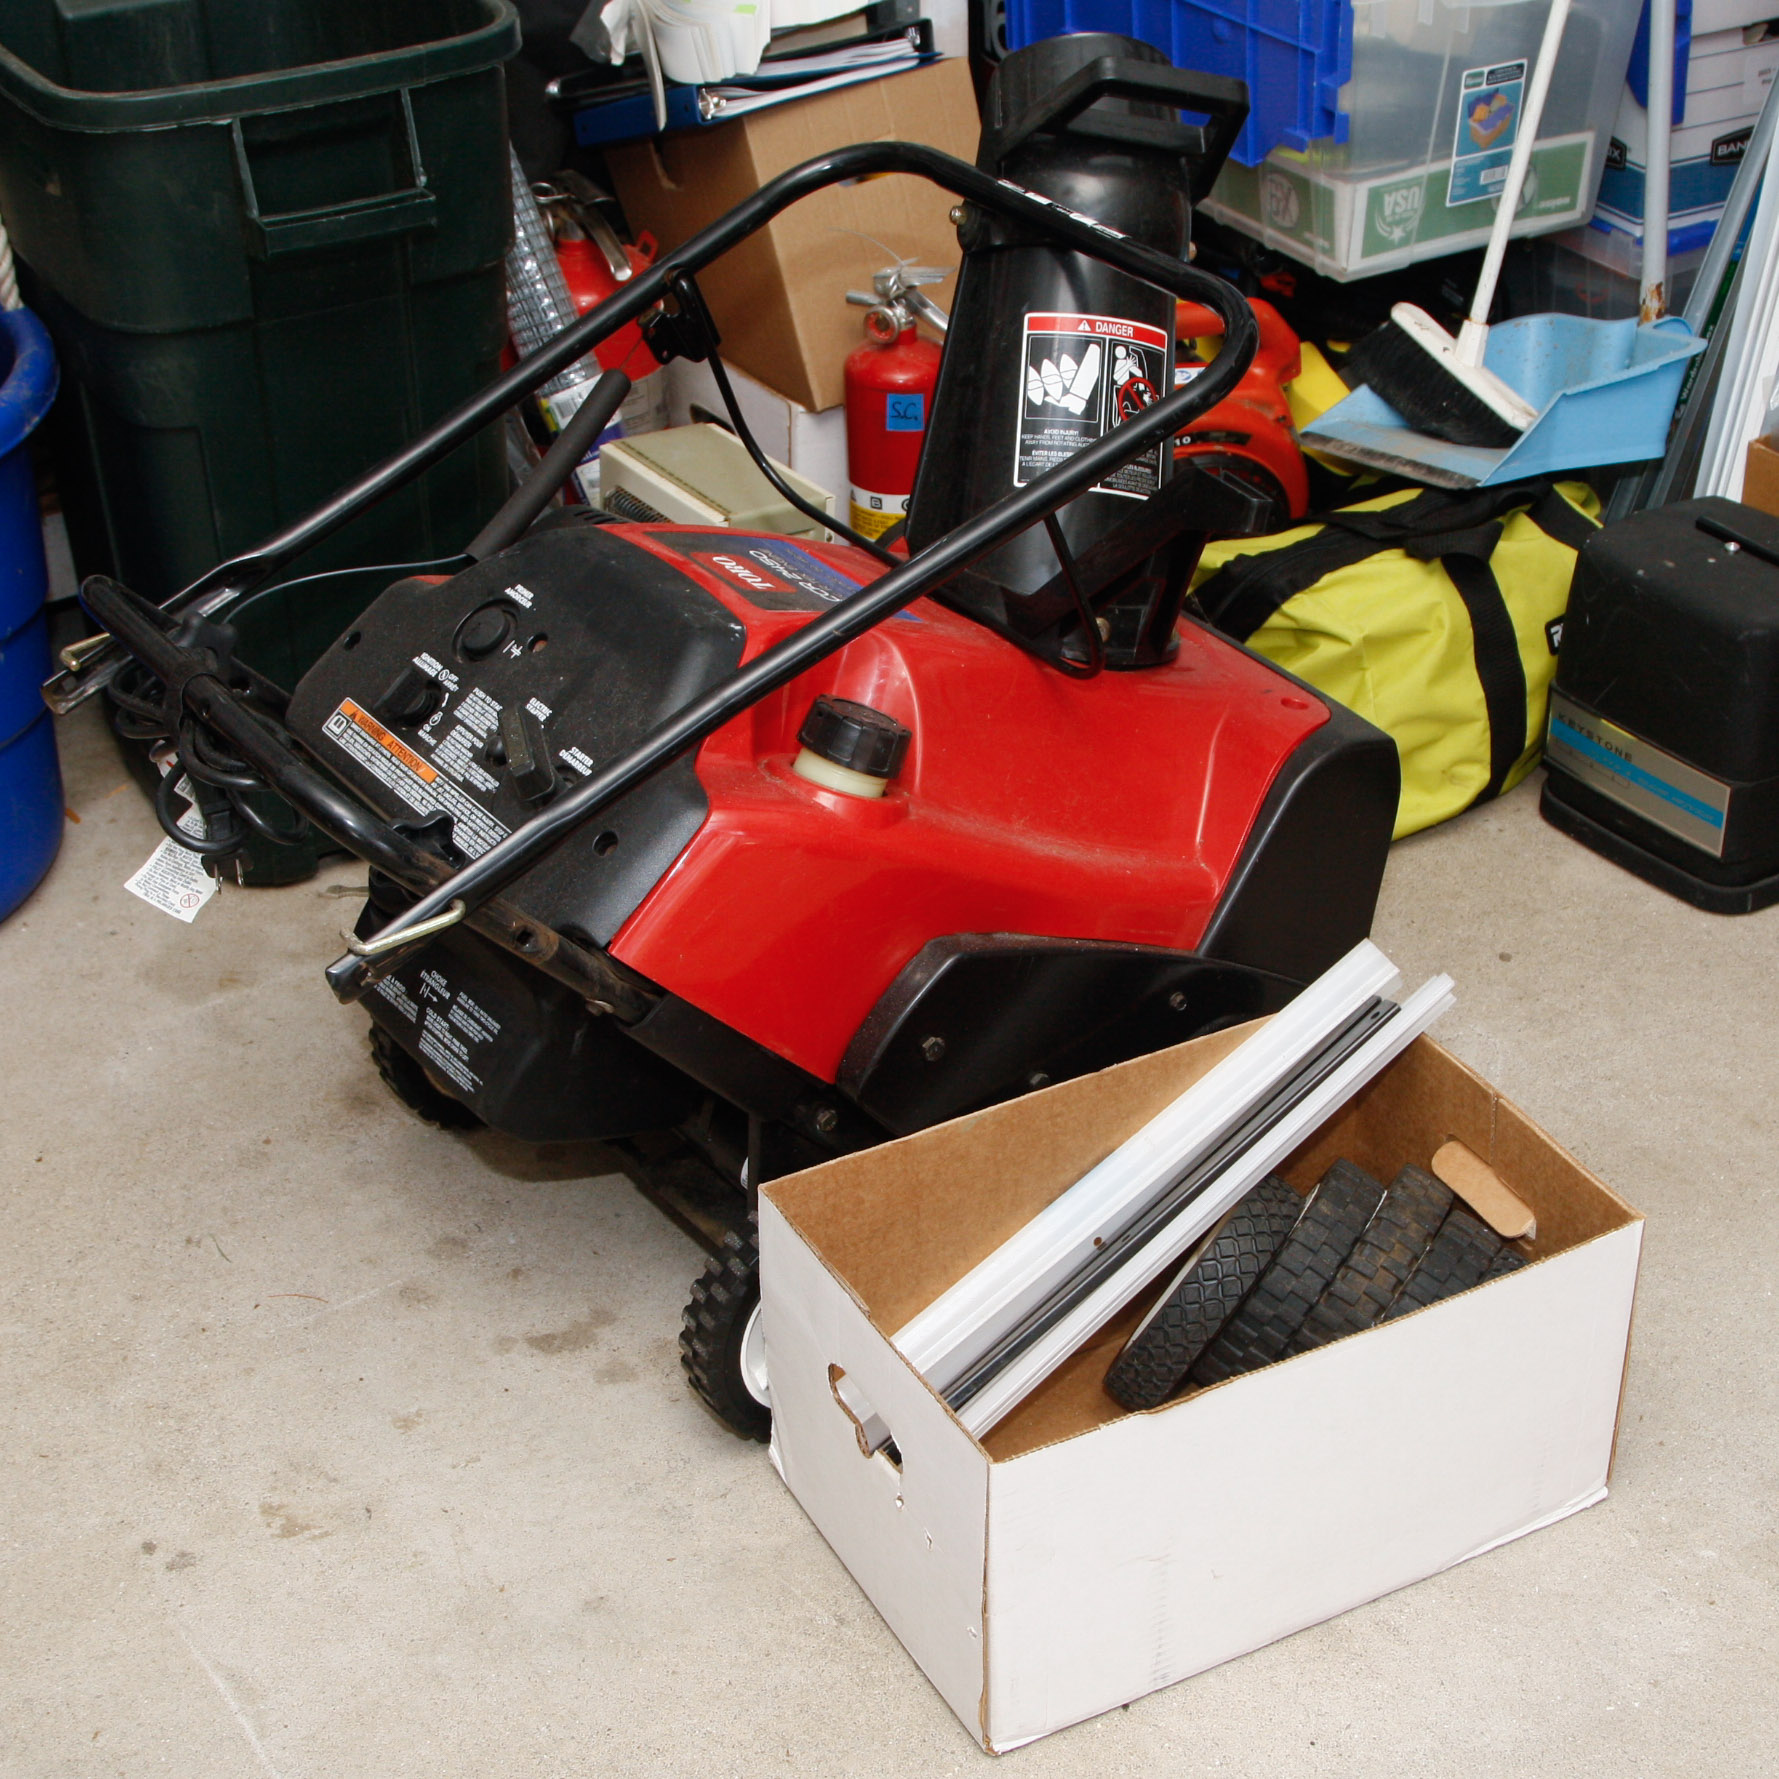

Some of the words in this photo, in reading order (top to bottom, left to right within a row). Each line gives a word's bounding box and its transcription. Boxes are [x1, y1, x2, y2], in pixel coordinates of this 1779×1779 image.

[1383, 185, 1420, 215] USA
[1095, 321, 1134, 338] DANGER
[711, 555, 777, 590] TORO
[748, 549, 803, 581] 2450
[515, 584, 534, 600] PRIMER
[797, 581, 843, 602] CCR
[420, 652, 443, 672] IGNITION
[447, 673, 459, 682] OFF
[473, 687, 486, 699] PUSH
[484, 696, 492, 704] TO
[490, 700, 503, 711] STAR
[529, 697, 552, 717] ELECTRIC
[423, 724, 432, 732] ON
[1558, 711, 1633, 762] KEYSTONE
[355, 717, 386, 741] WARNING
[384, 740, 421, 771] ATTENTION
[568, 747, 593, 767] STARTER
[420, 970, 450, 1000] ÉTRANGLEUR
[431, 970, 447, 987] CHOKE
